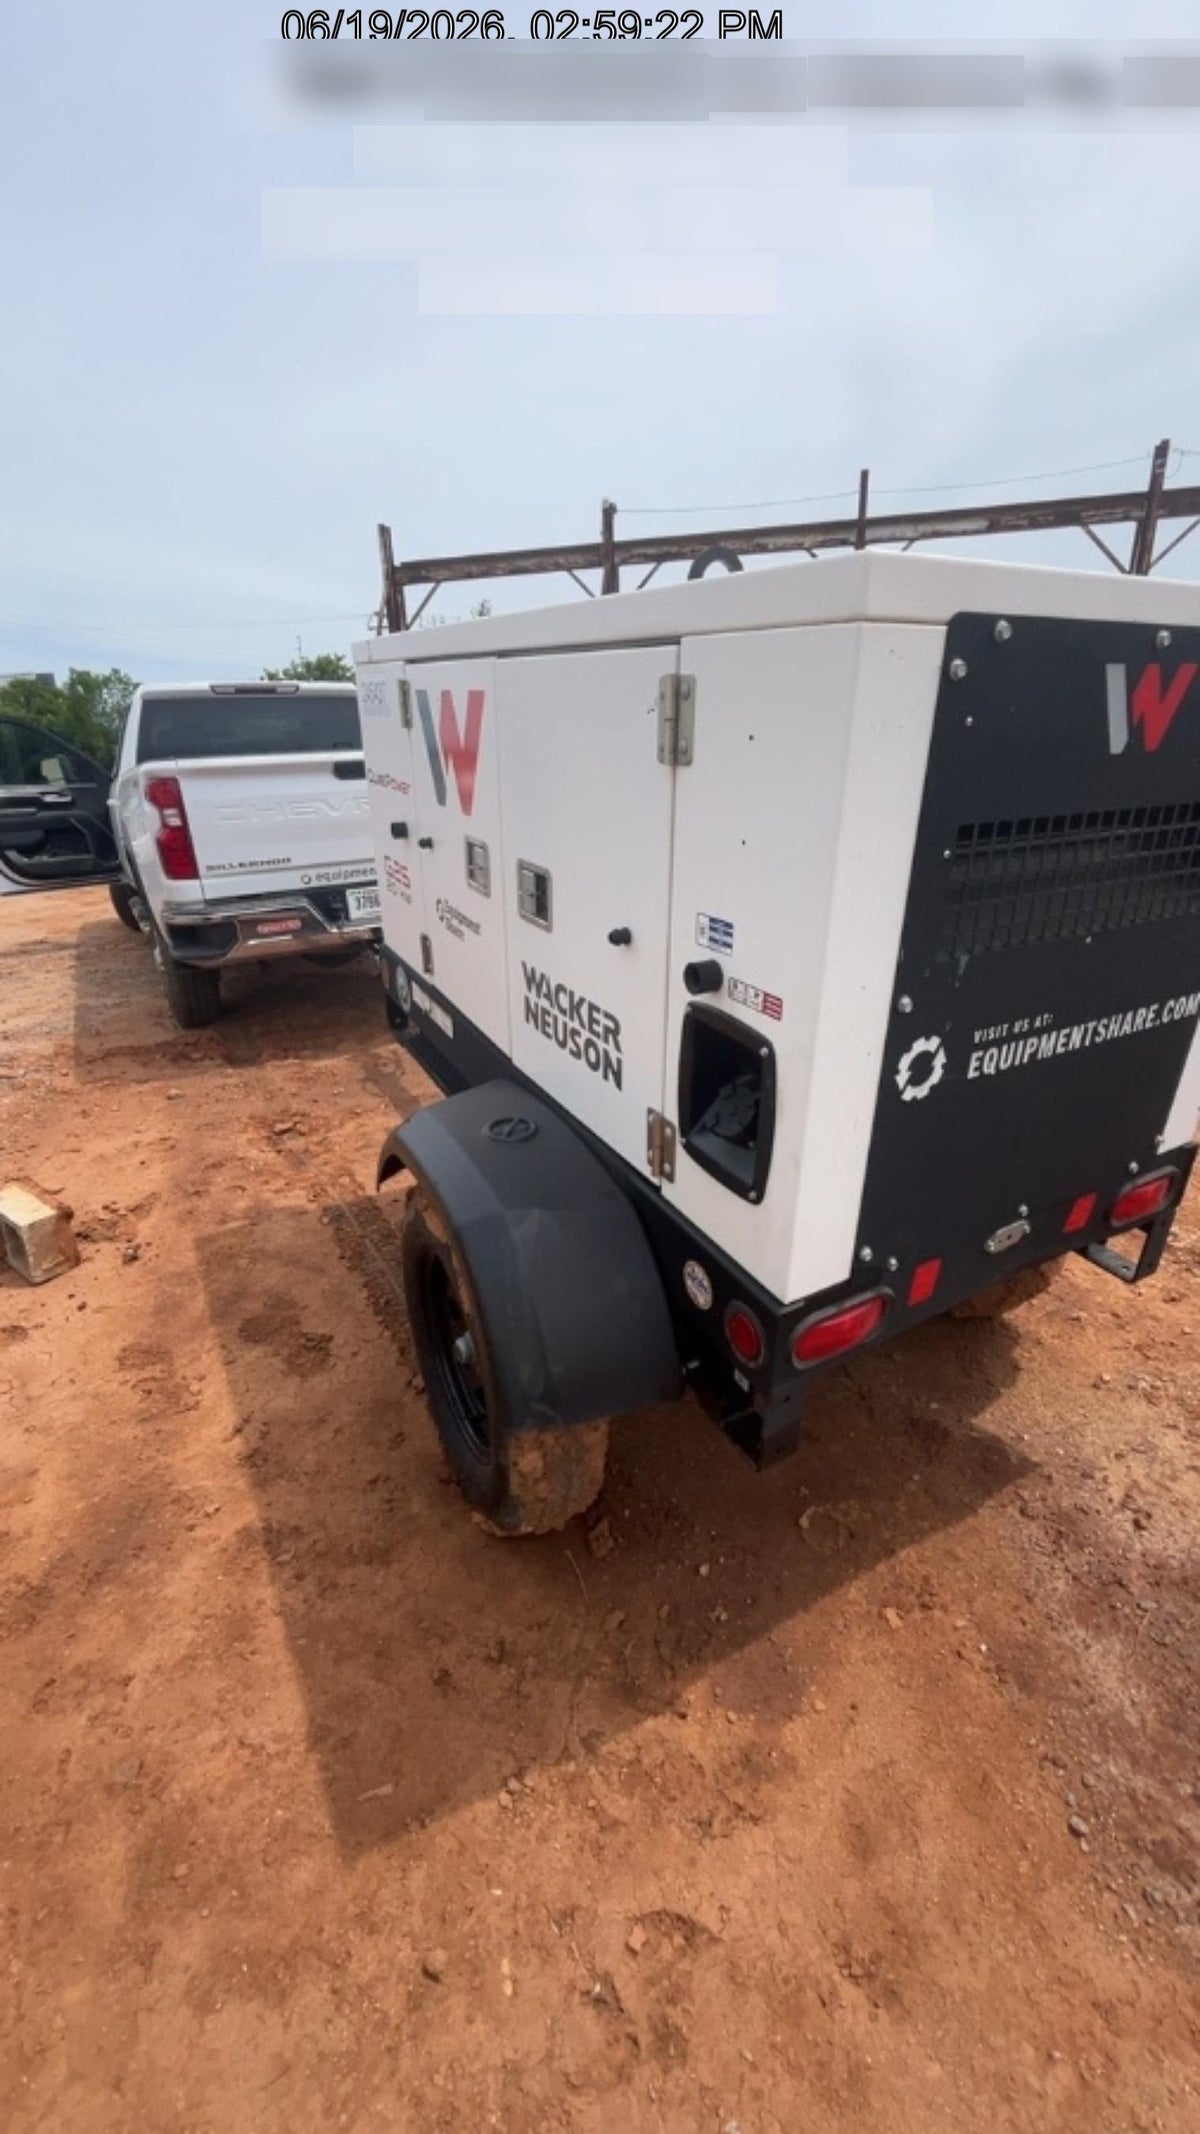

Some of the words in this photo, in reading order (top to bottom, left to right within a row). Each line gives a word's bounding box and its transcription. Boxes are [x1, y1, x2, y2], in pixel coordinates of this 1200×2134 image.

[521, 960, 622, 1054] WACKER
[523, 995, 623, 1092] NEUSON
[967, 991, 1200, 1080] EQUIPMENTSHARE.COM
[973, 1023, 1009, 1044] VISIT
[1012, 1018, 1030, 1034] US
